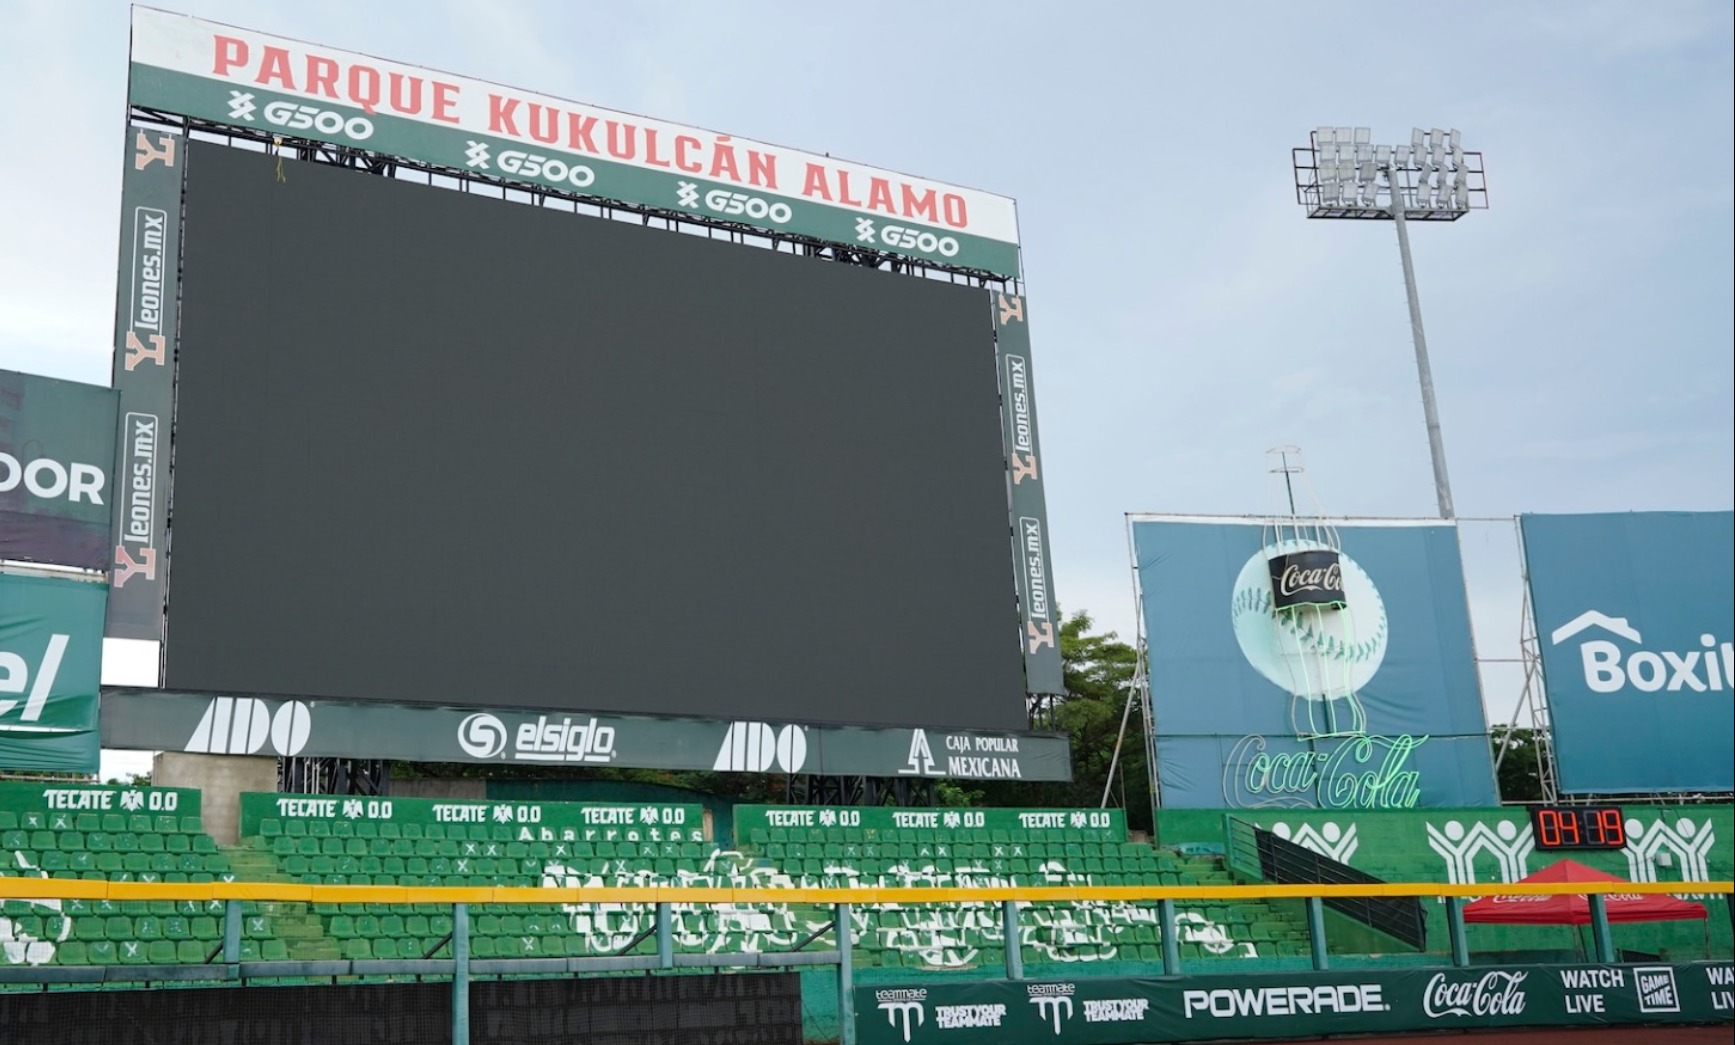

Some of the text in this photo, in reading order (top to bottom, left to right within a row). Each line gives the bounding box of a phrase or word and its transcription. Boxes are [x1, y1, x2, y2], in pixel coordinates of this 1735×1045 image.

[264, 100, 374, 140] G500
[212, 34, 968, 229] PARQUE KUKULCÁN ALAMO
[497, 150, 596, 188] G500
[705, 190, 793, 225] G500
[881, 225, 960, 258] G500
[134, 213, 164, 331] leones.mx
[1012, 360, 1030, 452] leones.mx
[123, 420, 155, 544] leones.mx
[1025, 522, 1046, 619] leones.mx
[946, 735, 1019, 753] CAJA POPULAR
[948, 756, 1022, 779] MEXICANA
[1222, 733, 1430, 808] Coca-Cola
[42, 789, 178, 811] TECATE 0.0
[276, 798, 393, 819] TECATE 0.0
[432, 804, 541, 823] TECATE 0.0
[581, 807, 685, 825] TECATE 0.0
[765, 809, 861, 827] TECATE 0.0
[892, 811, 986, 828] TECATE 0.0
[1018, 812, 1111, 829] TECATE 0.0
[1560, 969, 1625, 989] WATCH
[1640, 974, 1670, 994] GAME
[1423, 970, 1528, 1018] Coca-Cola
[1565, 994, 1606, 1014] LIVE
[1643, 985, 1674, 1006] TIME
